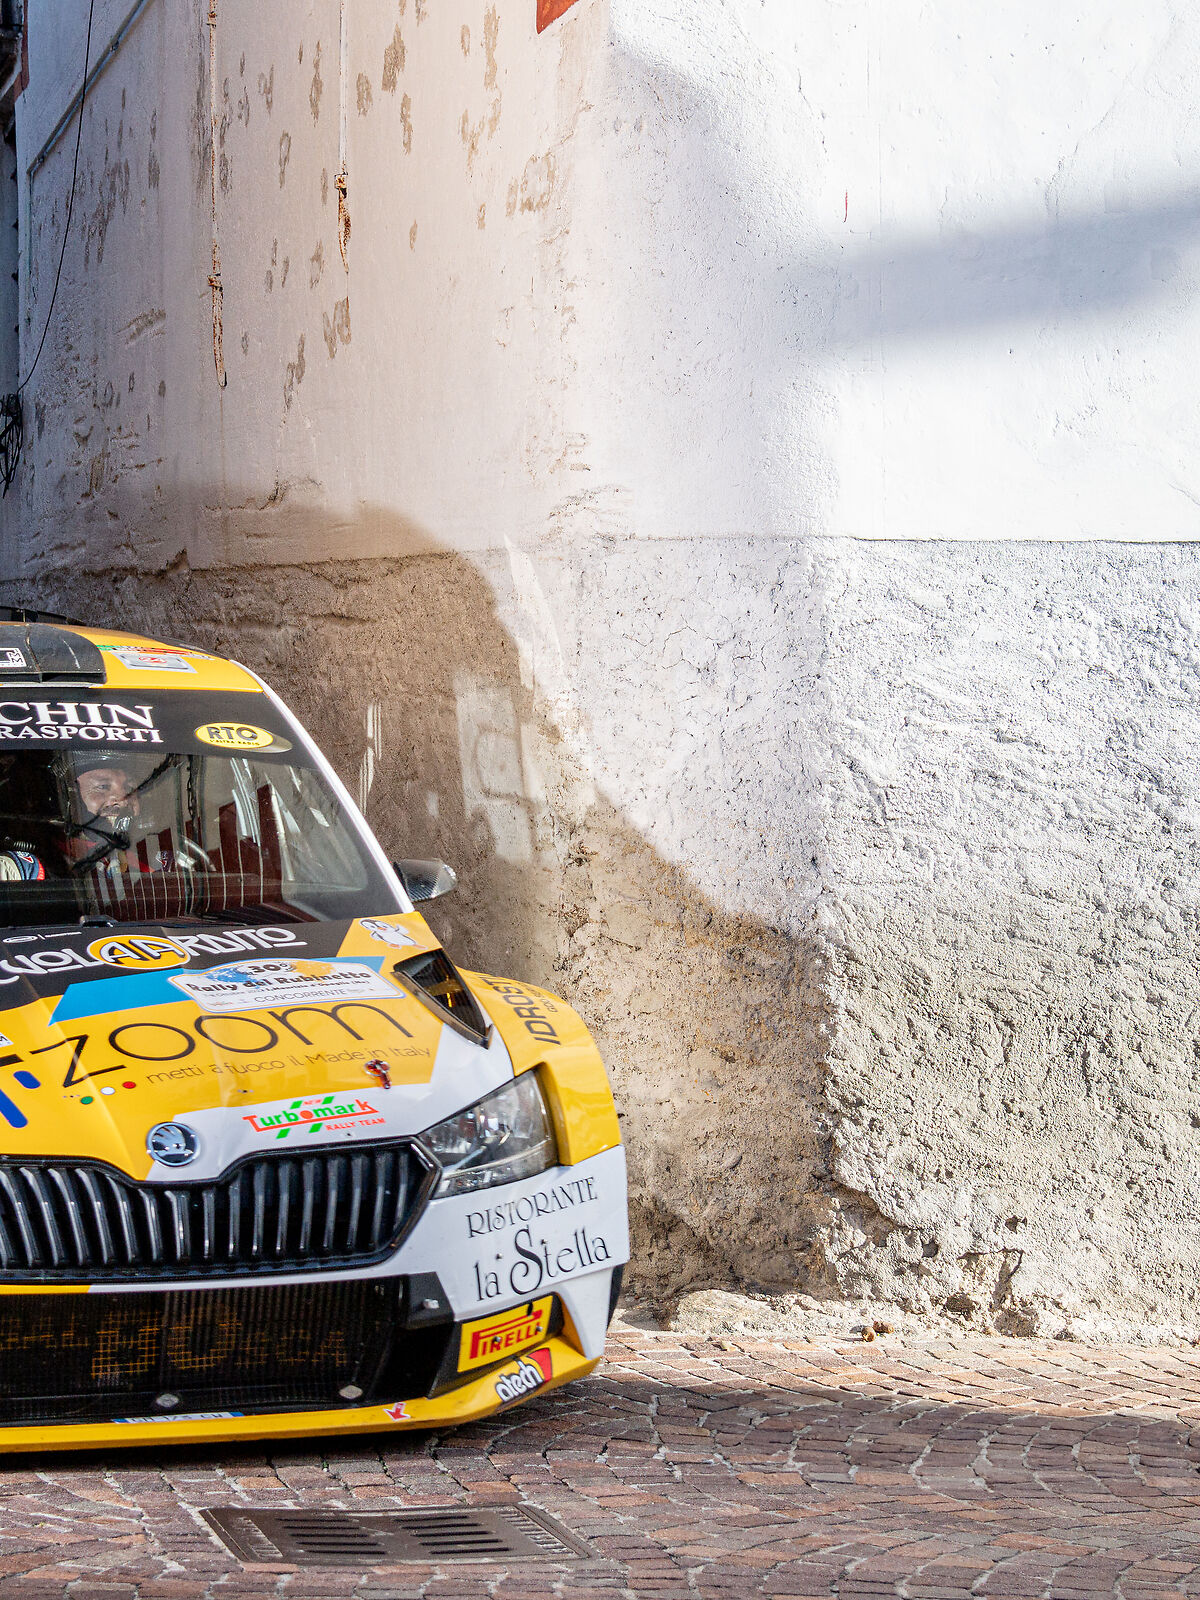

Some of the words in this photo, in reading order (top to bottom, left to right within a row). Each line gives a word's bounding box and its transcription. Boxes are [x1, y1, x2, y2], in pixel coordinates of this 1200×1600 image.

[206, 726, 258, 741] RTO
[186, 983, 238, 991] Rally
[243, 978, 273, 988] del
[274, 971, 372, 984] Rubinetto
[254, 988, 347, 1002] CONCORRENTE
[29, 1002, 413, 1088] zoom
[146, 1065, 204, 1084] metti
[224, 1058, 285, 1075] fuoco
[304, 1050, 365, 1065] Made
[367, 1048, 387, 1060] in
[390, 1045, 432, 1059] Italy
[325, 1121, 356, 1131] RALLY
[360, 1117, 386, 1127] TEAM
[465, 1176, 598, 1239] RISTORANTE
[473, 1259, 502, 1301] la
[510, 1224, 612, 1296] Stella
[469, 1309, 544, 1360] PIRELLI
[495, 1360, 543, 1402] atech
